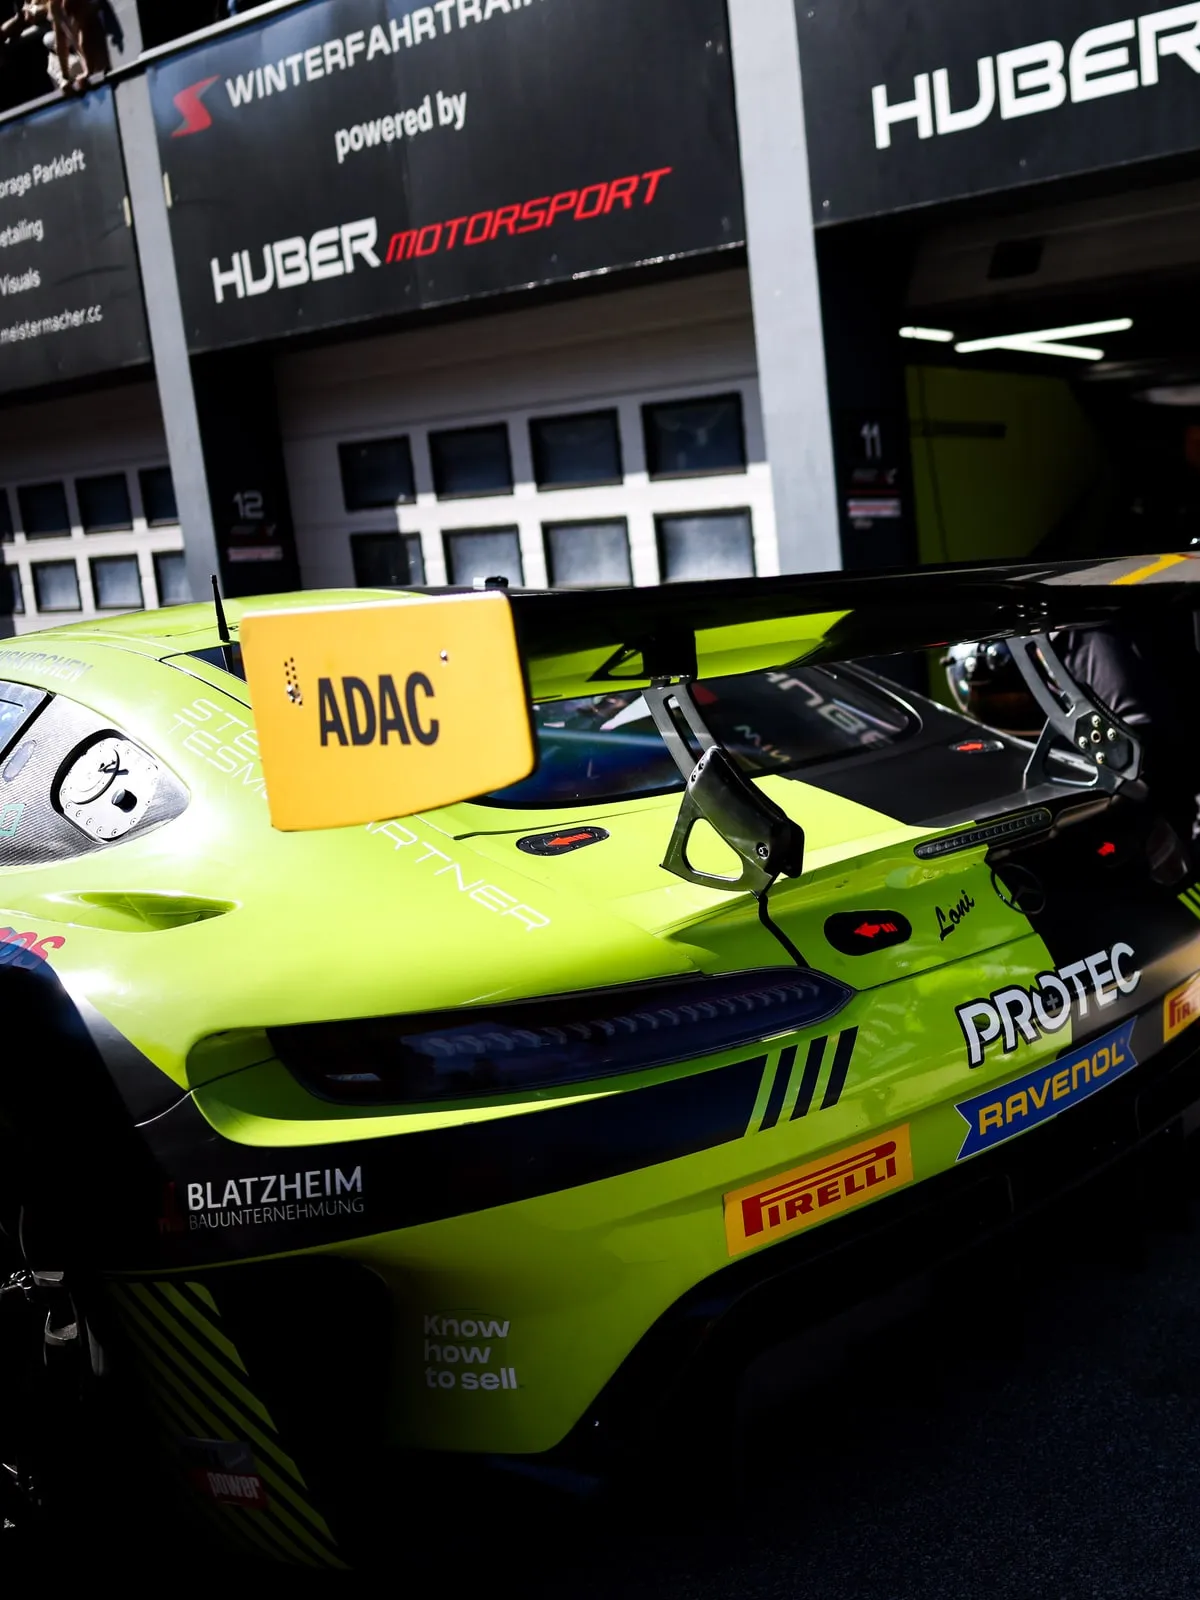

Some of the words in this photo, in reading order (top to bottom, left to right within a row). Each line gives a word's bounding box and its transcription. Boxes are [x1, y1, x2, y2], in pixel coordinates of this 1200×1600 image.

[334, 95, 433, 164] powered
[436, 91, 468, 131] by
[32, 149, 86, 186] Parkloft
[210, 217, 381, 304] HUBER
[385, 166, 673, 264] MOTORSPORT
[860, 420, 882, 461] 11
[231, 489, 265, 520] 12
[317, 671, 440, 747] ADAC
[365, 821, 551, 932] RTNER
[956, 942, 1142, 1067] PROTEC
[978, 1042, 1125, 1136] RAVENOL
[187, 1165, 364, 1212] BLATZHEIM
[741, 1140, 897, 1238] PIRELLI
[189, 1197, 366, 1231] BAUUNTERNEHMUNG
[423, 1314, 510, 1338] Know
[424, 1339, 491, 1364] how
[424, 1366, 456, 1389] to
